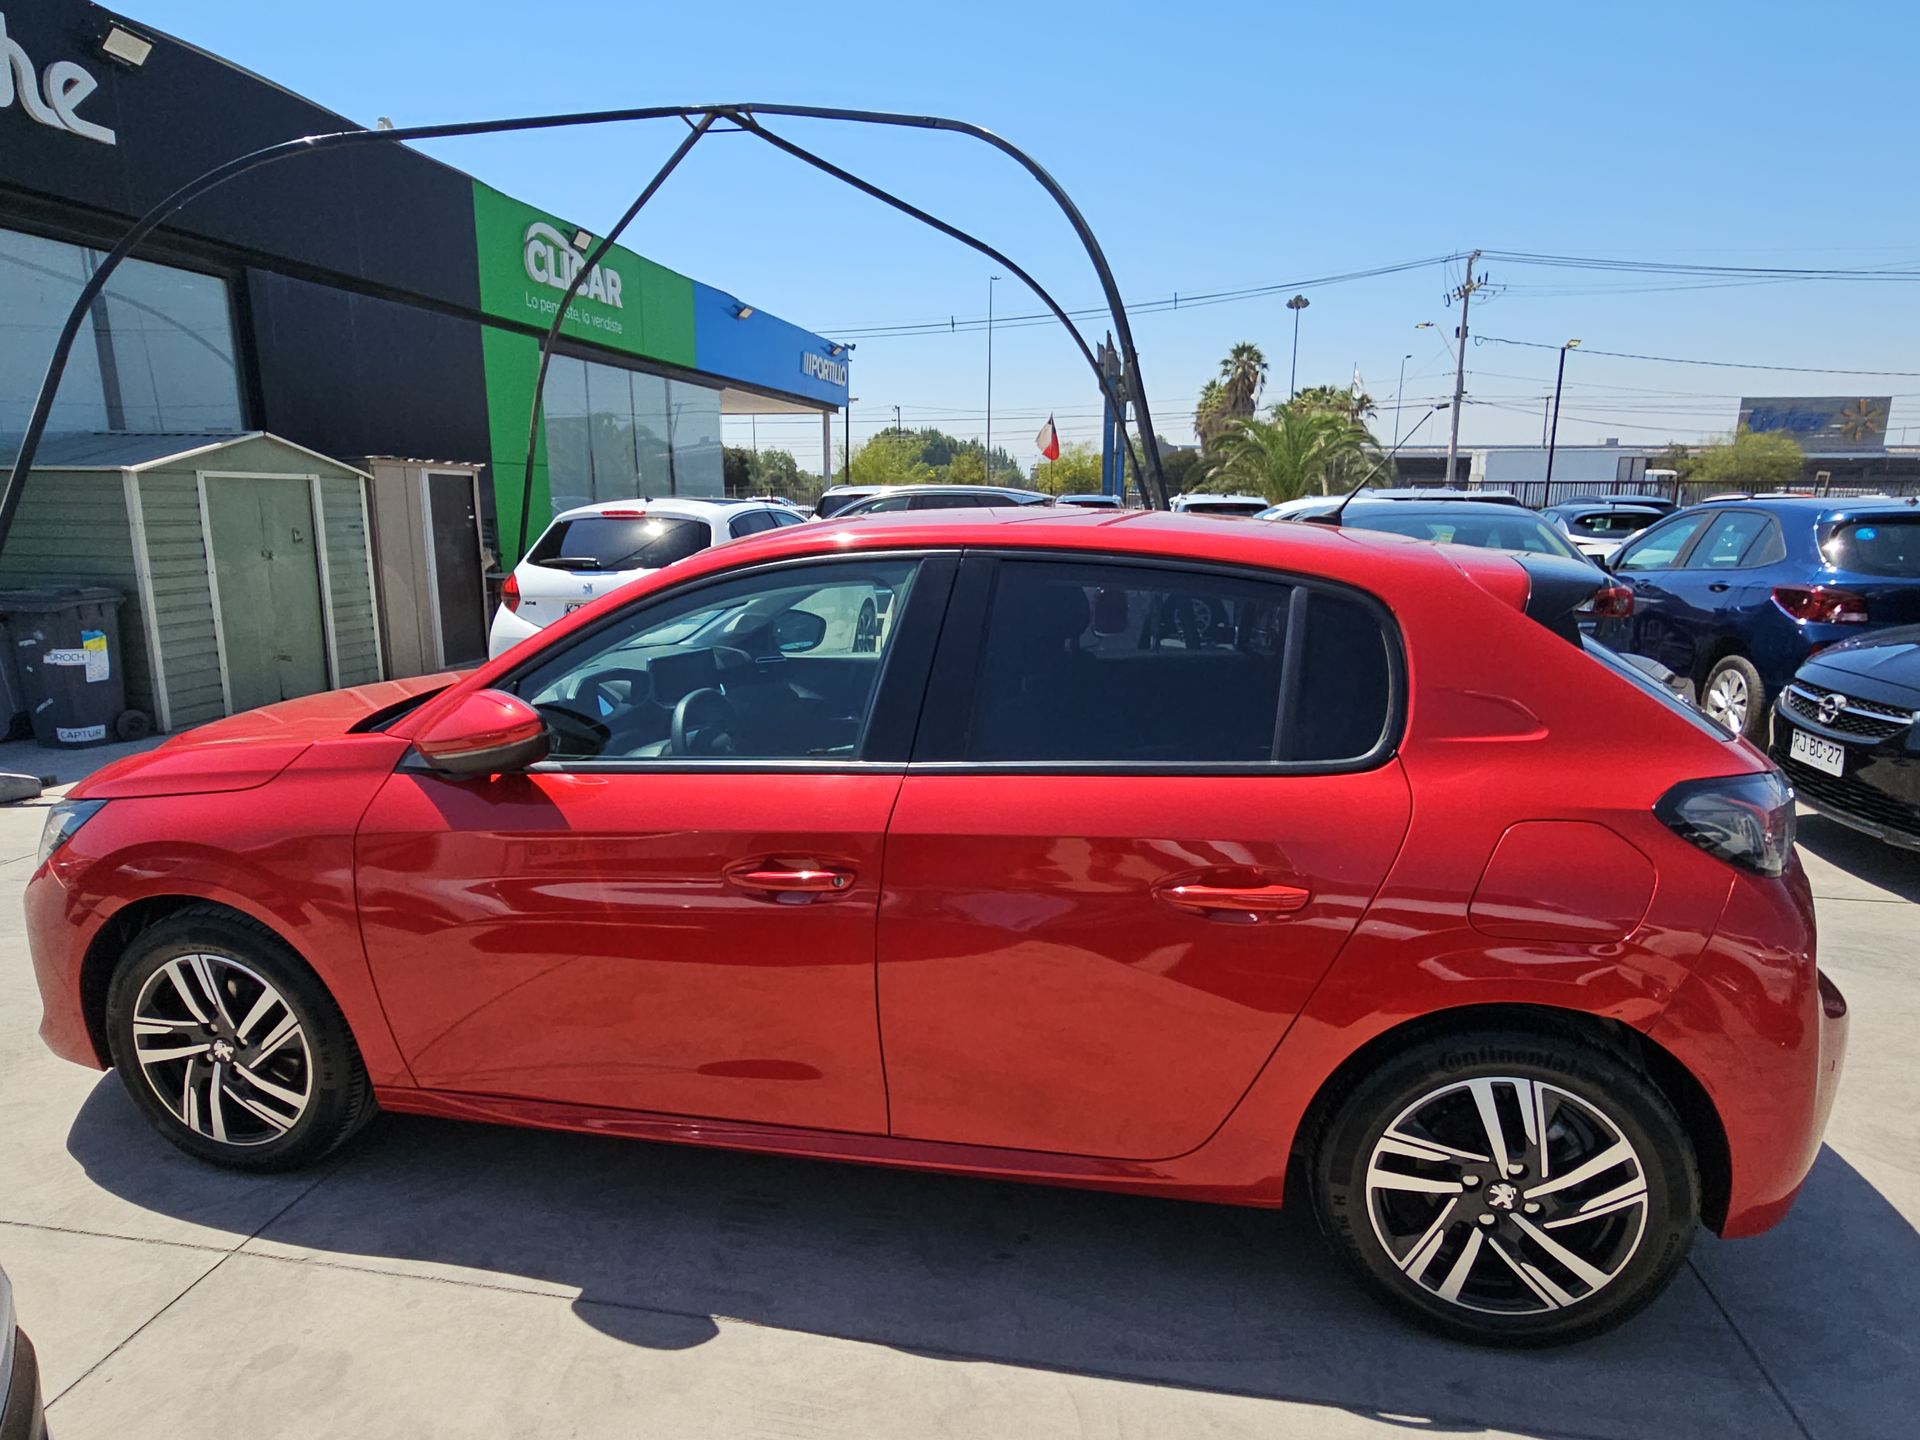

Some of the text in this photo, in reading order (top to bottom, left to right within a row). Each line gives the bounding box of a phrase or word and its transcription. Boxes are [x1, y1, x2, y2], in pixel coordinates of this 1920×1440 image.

[525, 290, 623, 335] Lo penste, lo vendiste
[811, 353, 847, 387] PORTILLO
[60, 728, 102, 740] CAPTUR
[1438, 1045, 1578, 1074] Continental
